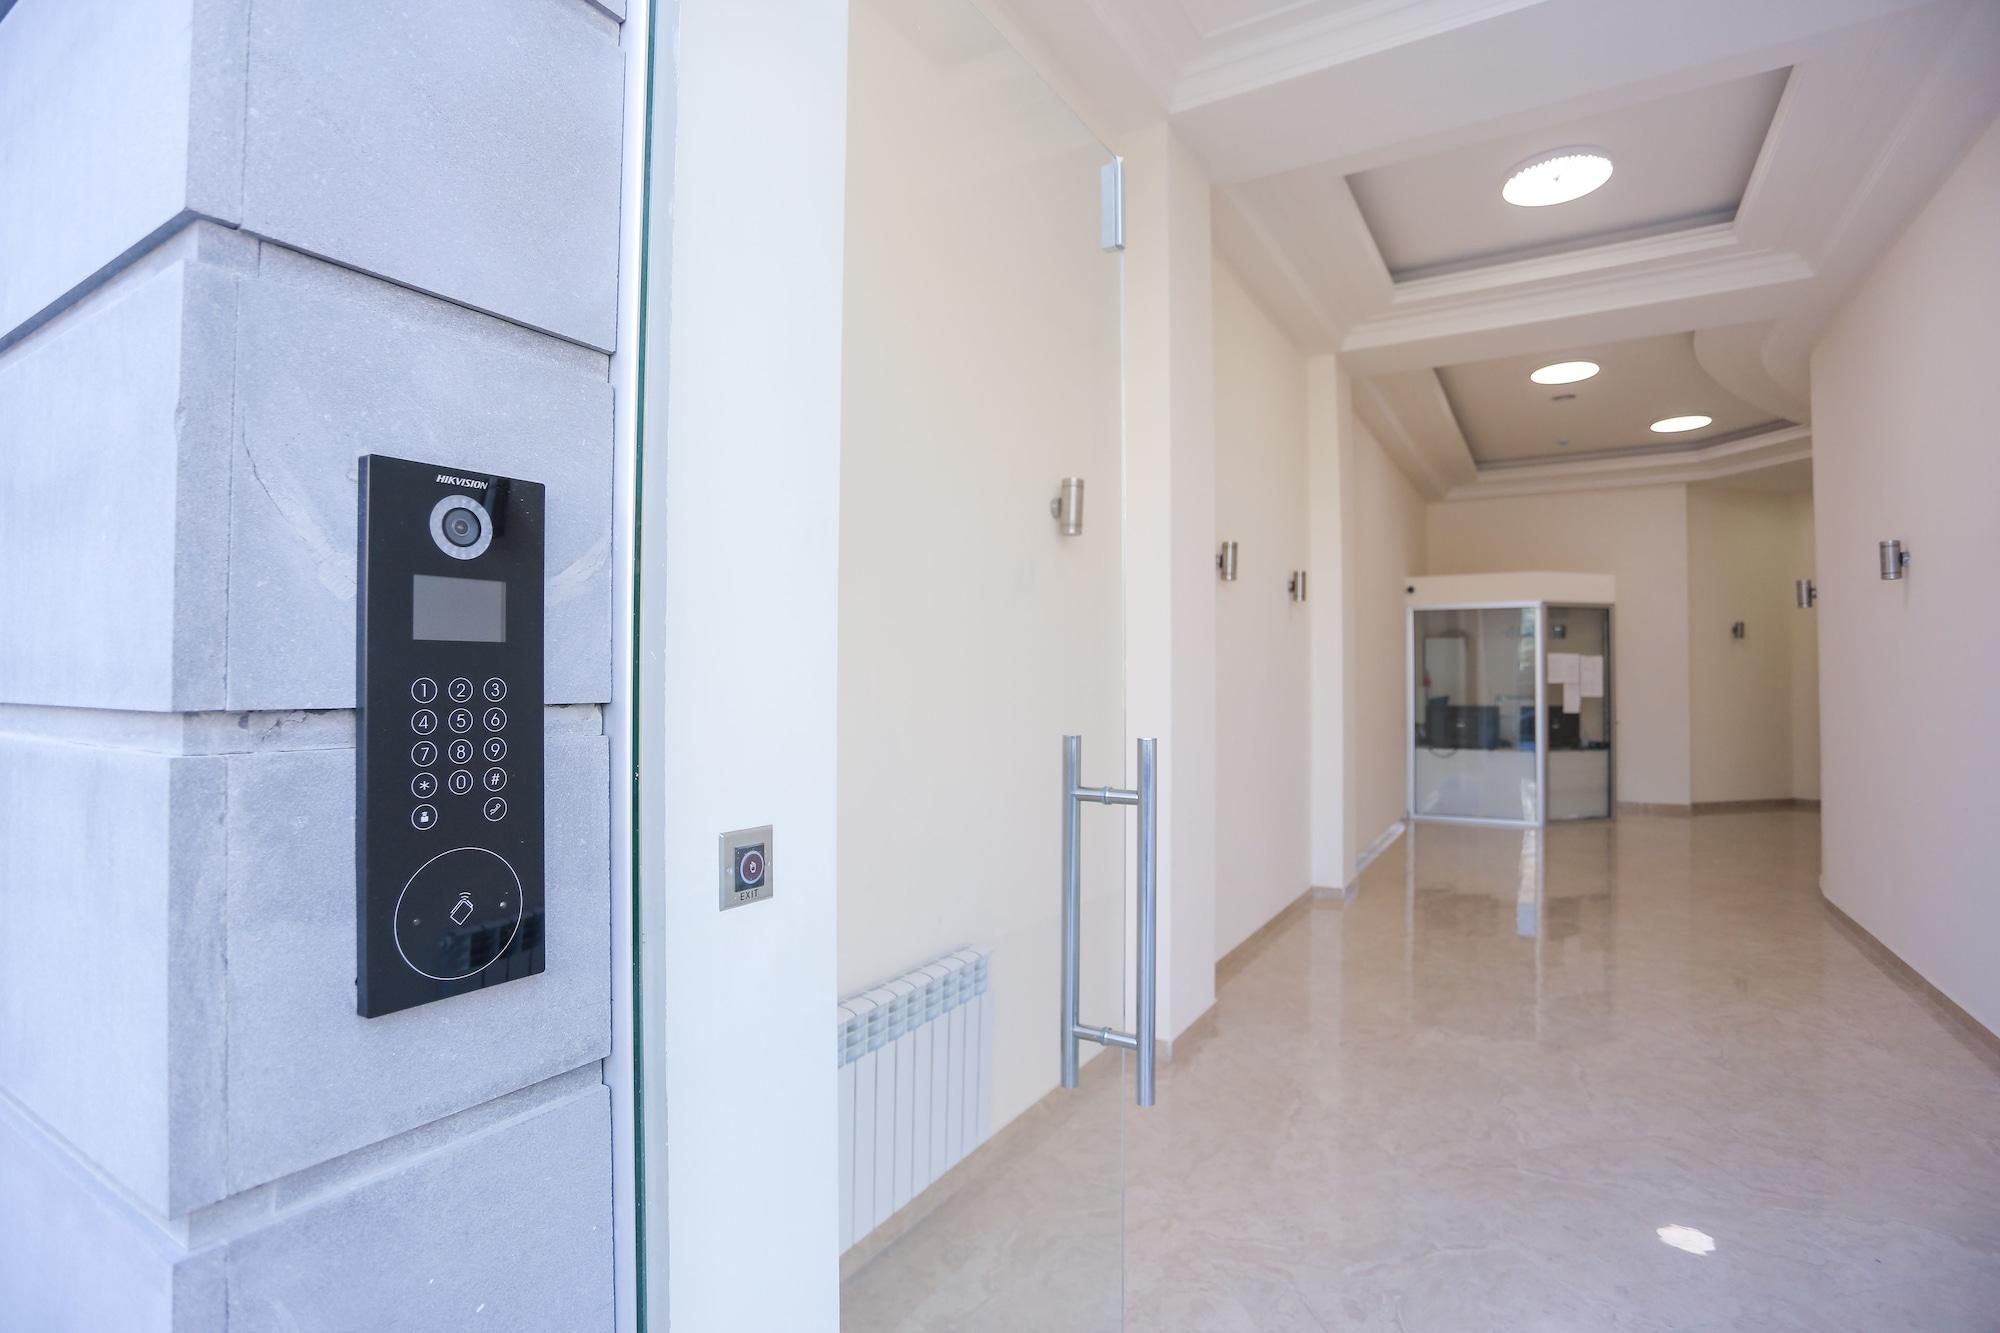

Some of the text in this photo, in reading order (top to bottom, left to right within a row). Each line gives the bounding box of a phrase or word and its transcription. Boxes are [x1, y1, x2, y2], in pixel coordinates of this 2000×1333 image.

[436, 474, 489, 490] HIKVISION
[421, 683, 500, 698] 1 2 3
[418, 713, 500, 729] 4 5 6
[420, 743, 500, 761] 7 8 9
[456, 775, 466, 789] 0
[740, 888, 759, 901] EXIT
